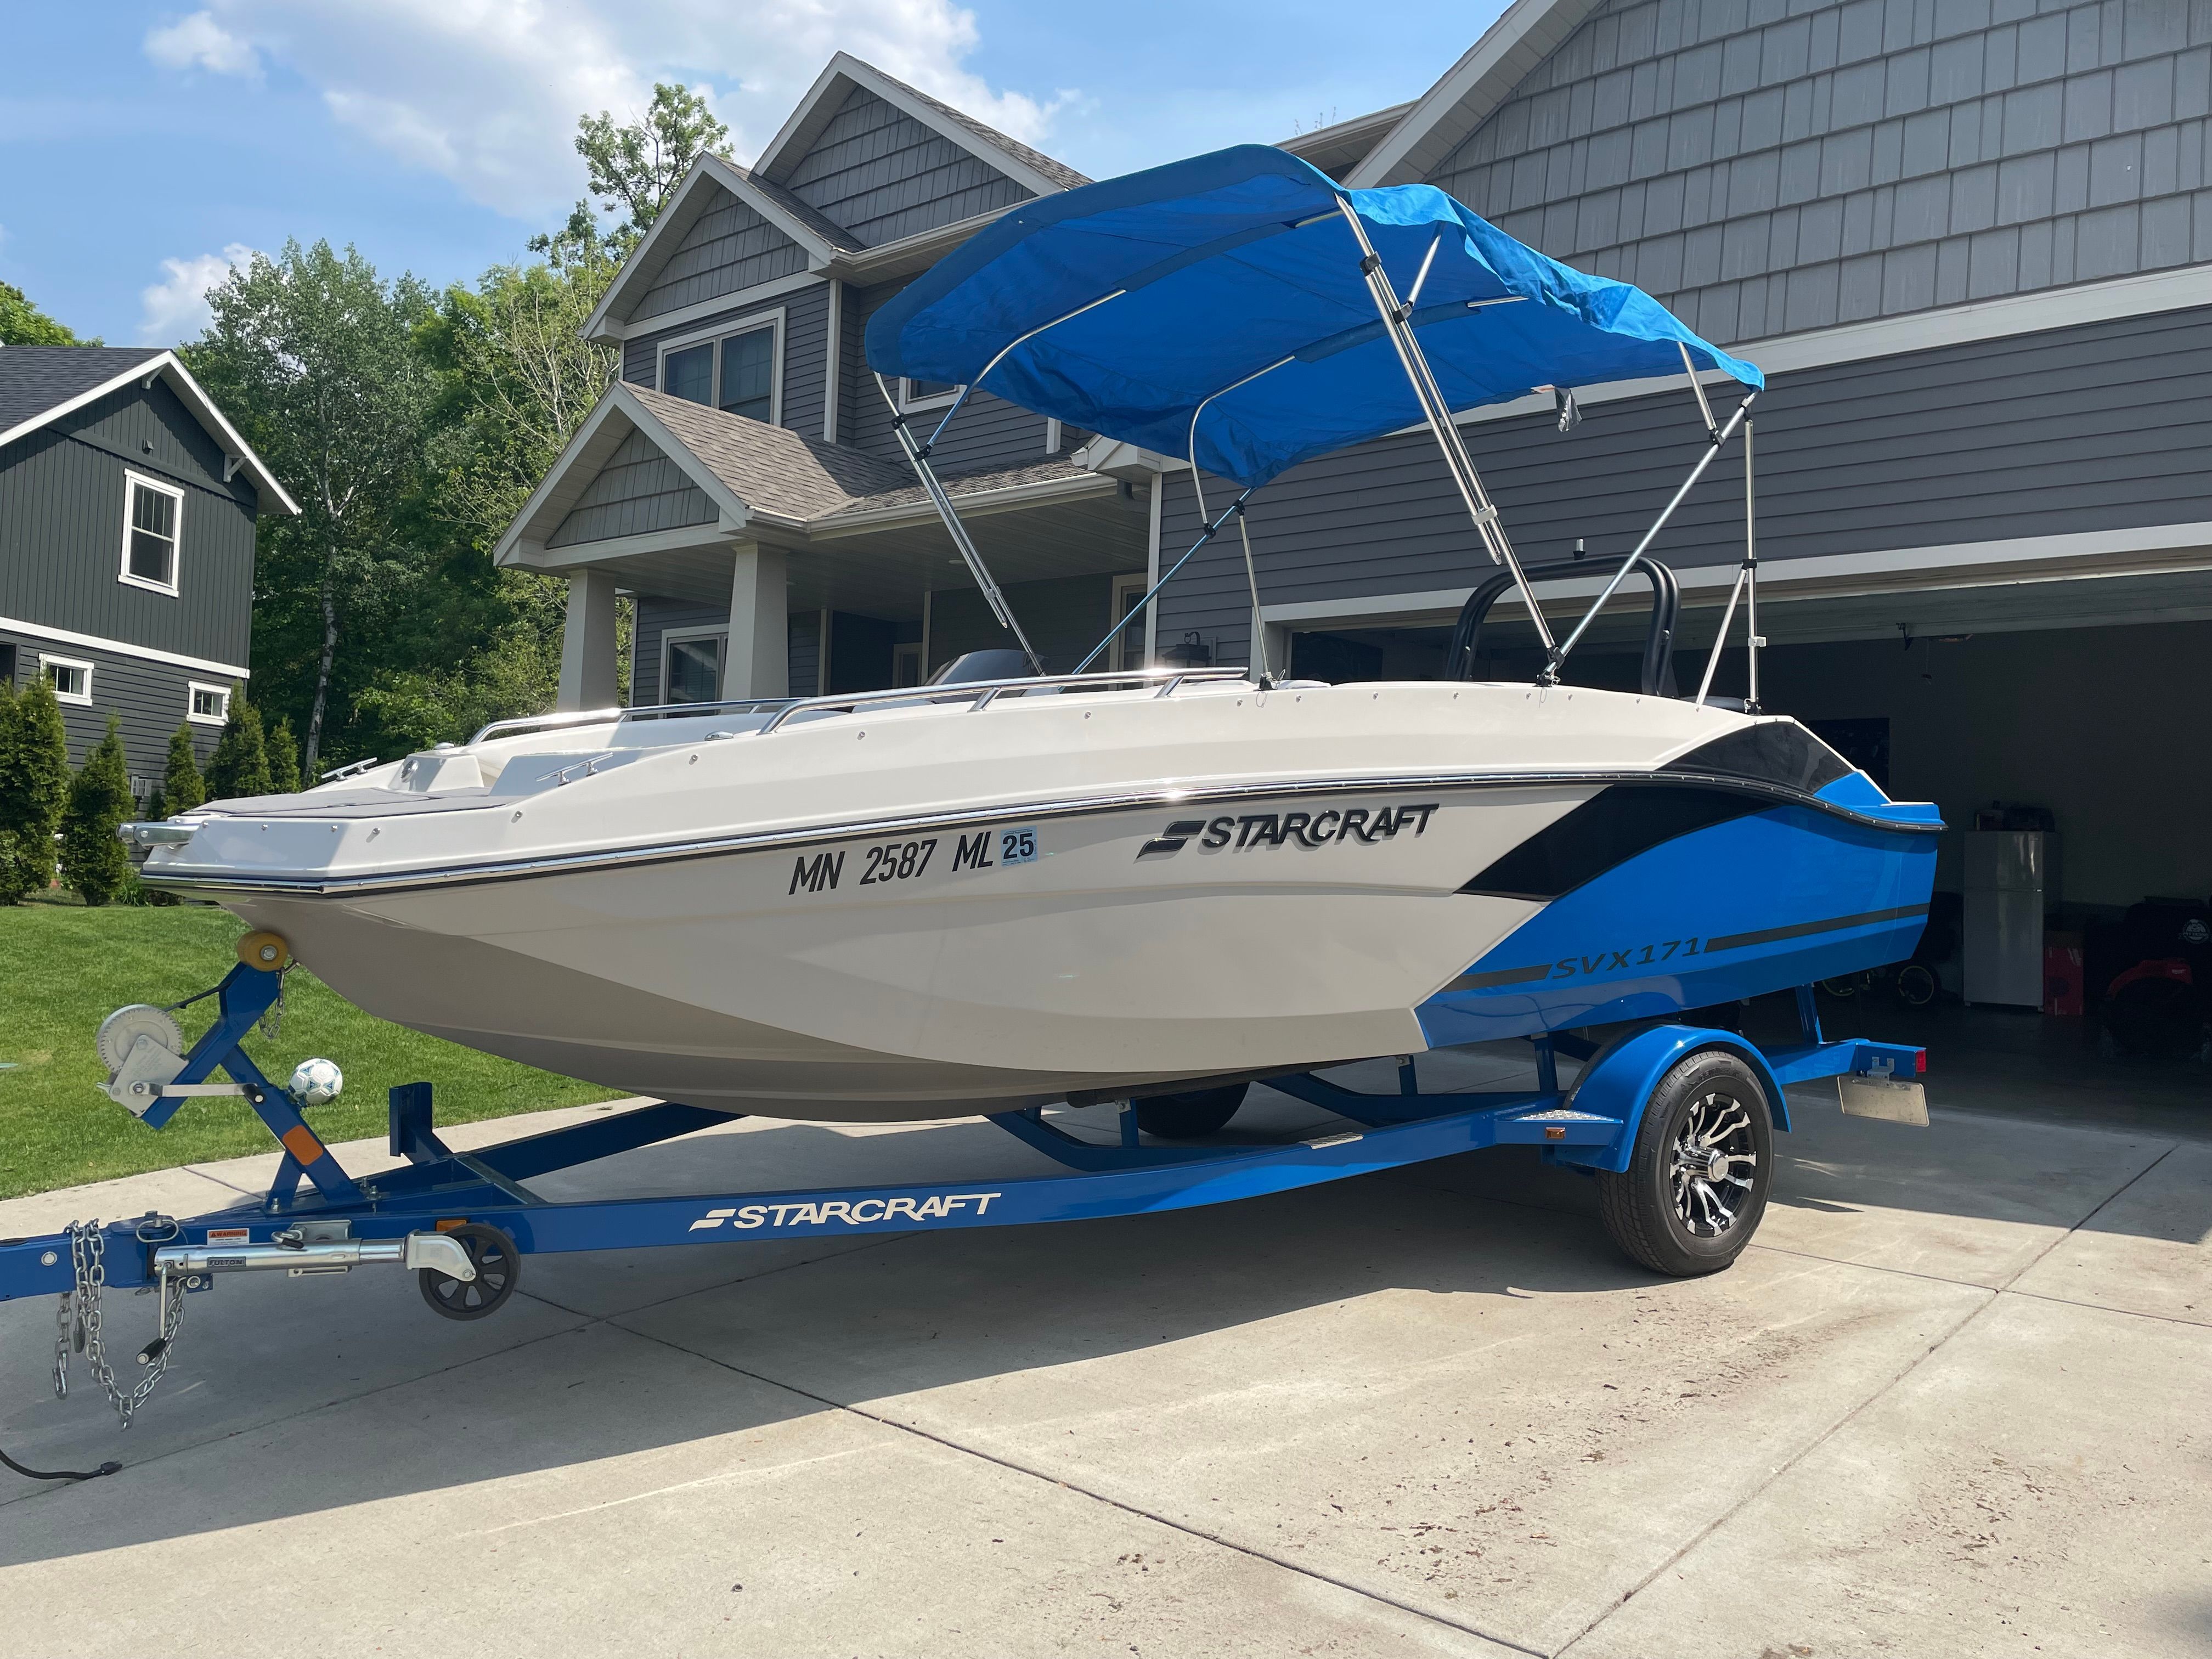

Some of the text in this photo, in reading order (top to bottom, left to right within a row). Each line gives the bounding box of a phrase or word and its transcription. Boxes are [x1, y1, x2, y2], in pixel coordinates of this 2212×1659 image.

[1003, 832, 1034, 860] 25
[1201, 803, 1440, 847] STARCRAFT
[788, 831, 994, 895] MN 2587 ML
[1552, 937, 1700, 979] SVX171
[733, 1193, 1002, 1229] STARCRAFT
